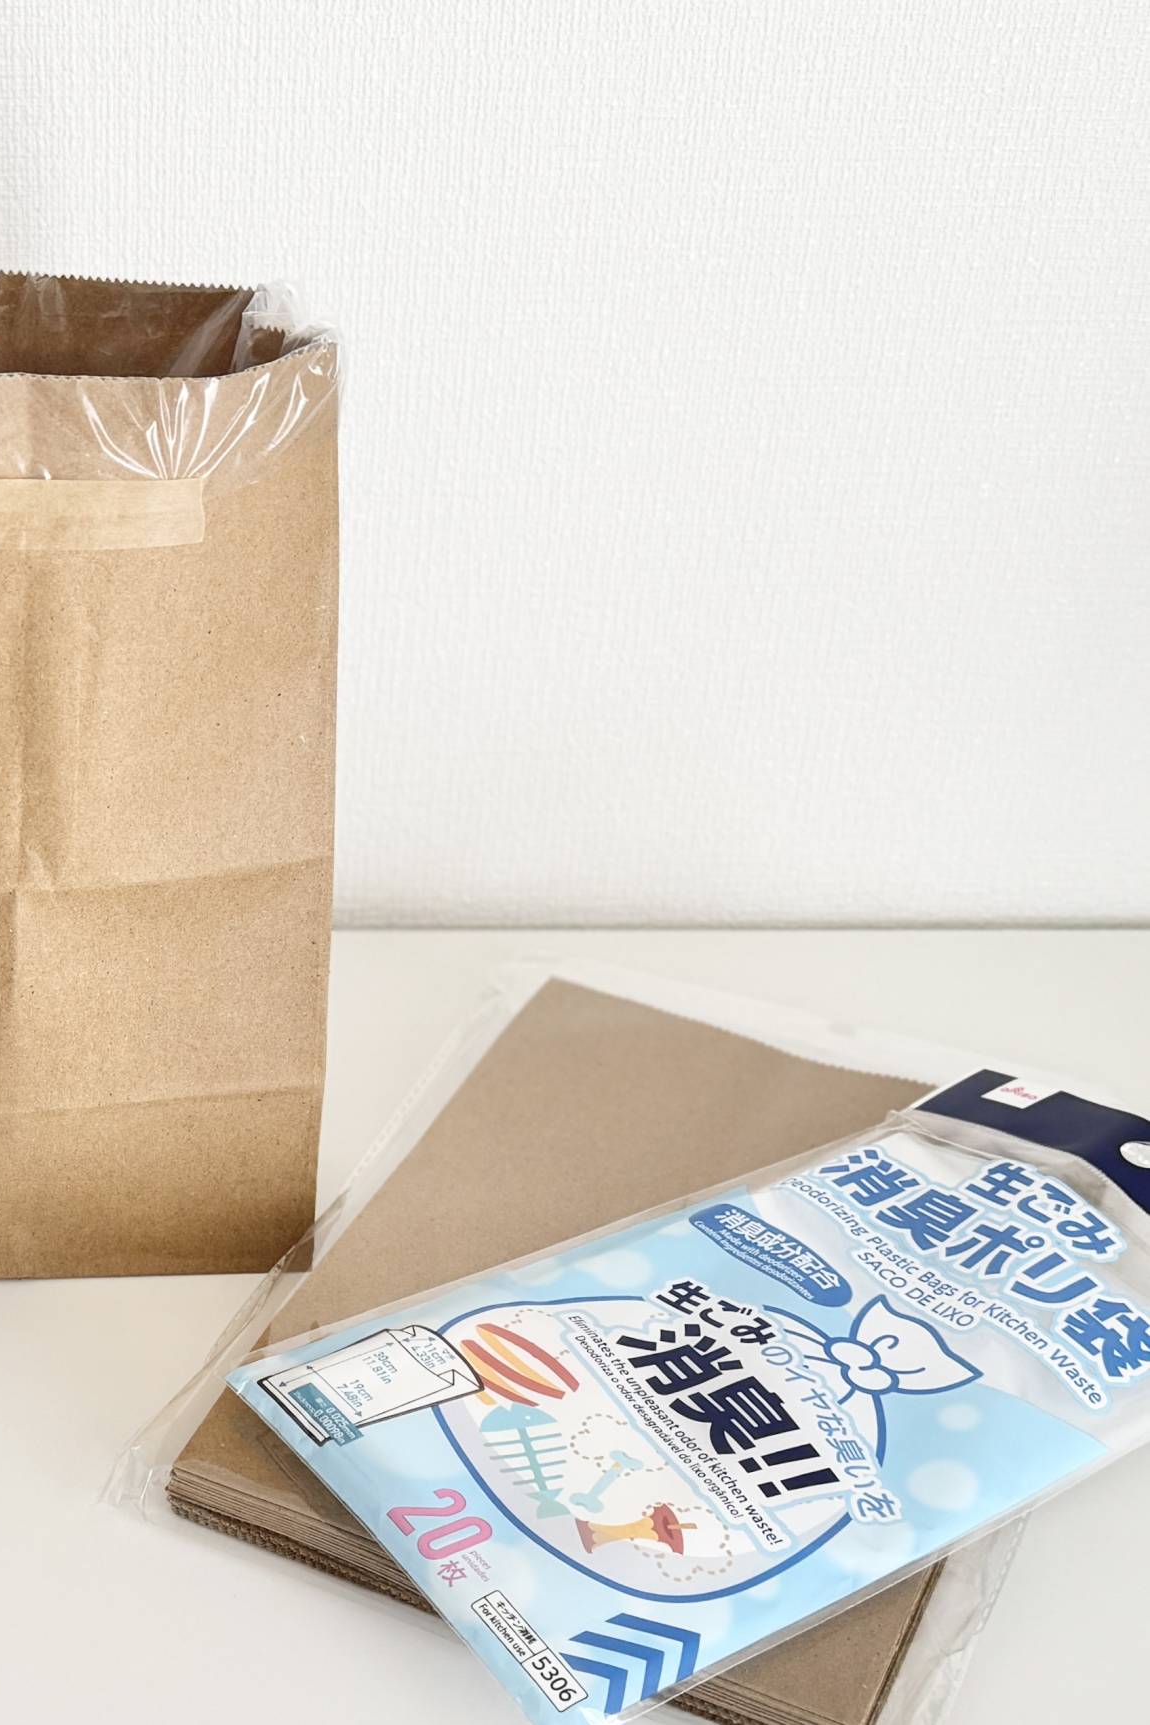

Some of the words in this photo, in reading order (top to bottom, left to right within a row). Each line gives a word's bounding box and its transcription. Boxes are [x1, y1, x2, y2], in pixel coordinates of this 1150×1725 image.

[966, 1162, 1117, 1255] 生ごみ
[714, 1209, 841, 1290] 消臭成分配合
[721, 1229, 742, 1245] Made
[740, 1241, 761, 1258] with
[819, 1149, 1150, 1378] 消臭ポリ袋
[857, 1252, 907, 1289] SACO
[905, 1287, 930, 1308] DE
[931, 1297, 976, 1328] LIXO
[866, 1236, 920, 1275] Plastic
[918, 1272, 957, 1302] Bags
[959, 1290, 986, 1309] for
[982, 1302, 1048, 1351] Kitchen
[1051, 1348, 1103, 1405] Waste
[374, 1351, 398, 1375] 30cm
[425, 1343, 447, 1366] 11cm
[337, 1384, 363, 1409] 7.48in
[349, 1379, 374, 1402] 19cm
[567, 1315, 616, 1362] Eliminates
[610, 1355, 630, 1379] the
[626, 1372, 680, 1434] unpleasant
[674, 1426, 704, 1456] odor
[698, 1449, 715, 1466] of
[709, 1458, 749, 1506] kitchen
[743, 1498, 786, 1547] waste!
[574, 1334, 614, 1379] Desodoriza
[613, 1380, 637, 1411] odor
[630, 1401, 685, 1462] desagradável
[677, 1451, 694, 1468] do
[688, 1459, 707, 1484] lixo
[702, 1478, 744, 1520] orgânico!
[386, 1488, 493, 1560] 20
[437, 1560, 467, 1587] 枚
[478, 1603, 493, 1619] For
[489, 1615, 515, 1644] kitchen
[512, 1642, 527, 1658] use
[531, 1655, 577, 1702] 5306
